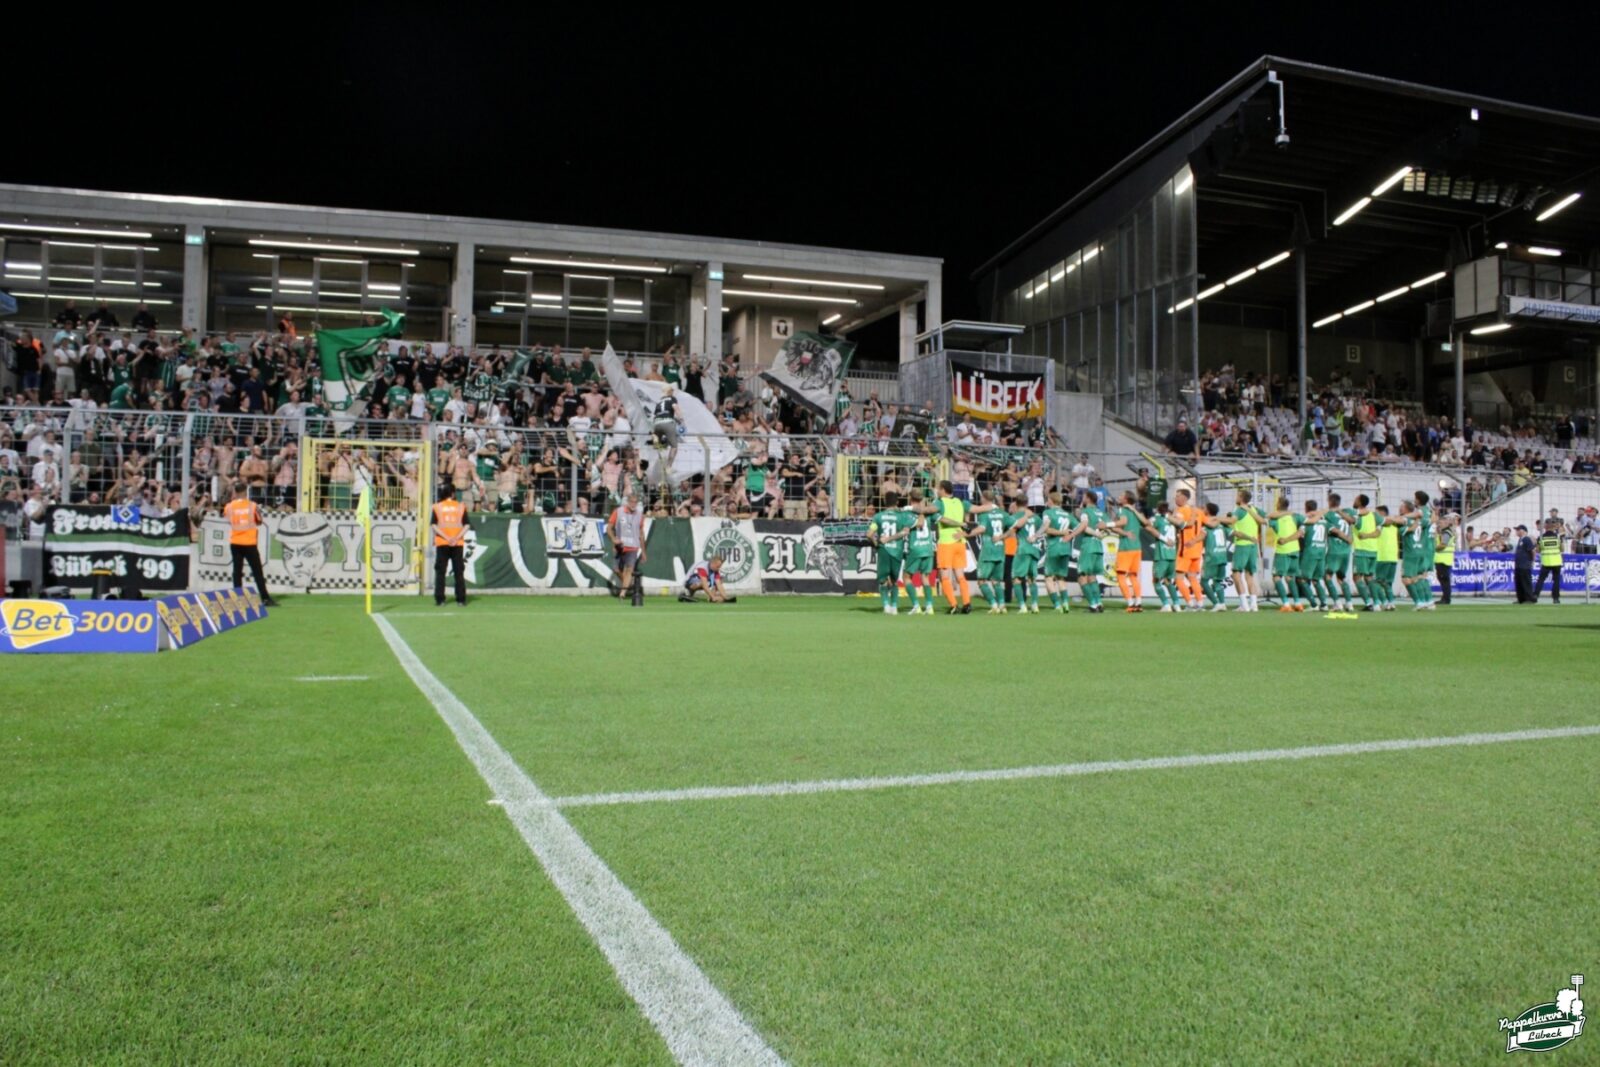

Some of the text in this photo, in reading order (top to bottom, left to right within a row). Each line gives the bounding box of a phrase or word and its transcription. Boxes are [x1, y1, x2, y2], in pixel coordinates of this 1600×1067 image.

[776, 319, 788, 336] Q
[1350, 347, 1358, 361] B
[1566, 368, 1574, 381] C
[956, 370, 1042, 415] LÜBECK
[52, 508, 176, 537] Fronide
[12, 608, 153, 634] Bet 3000
